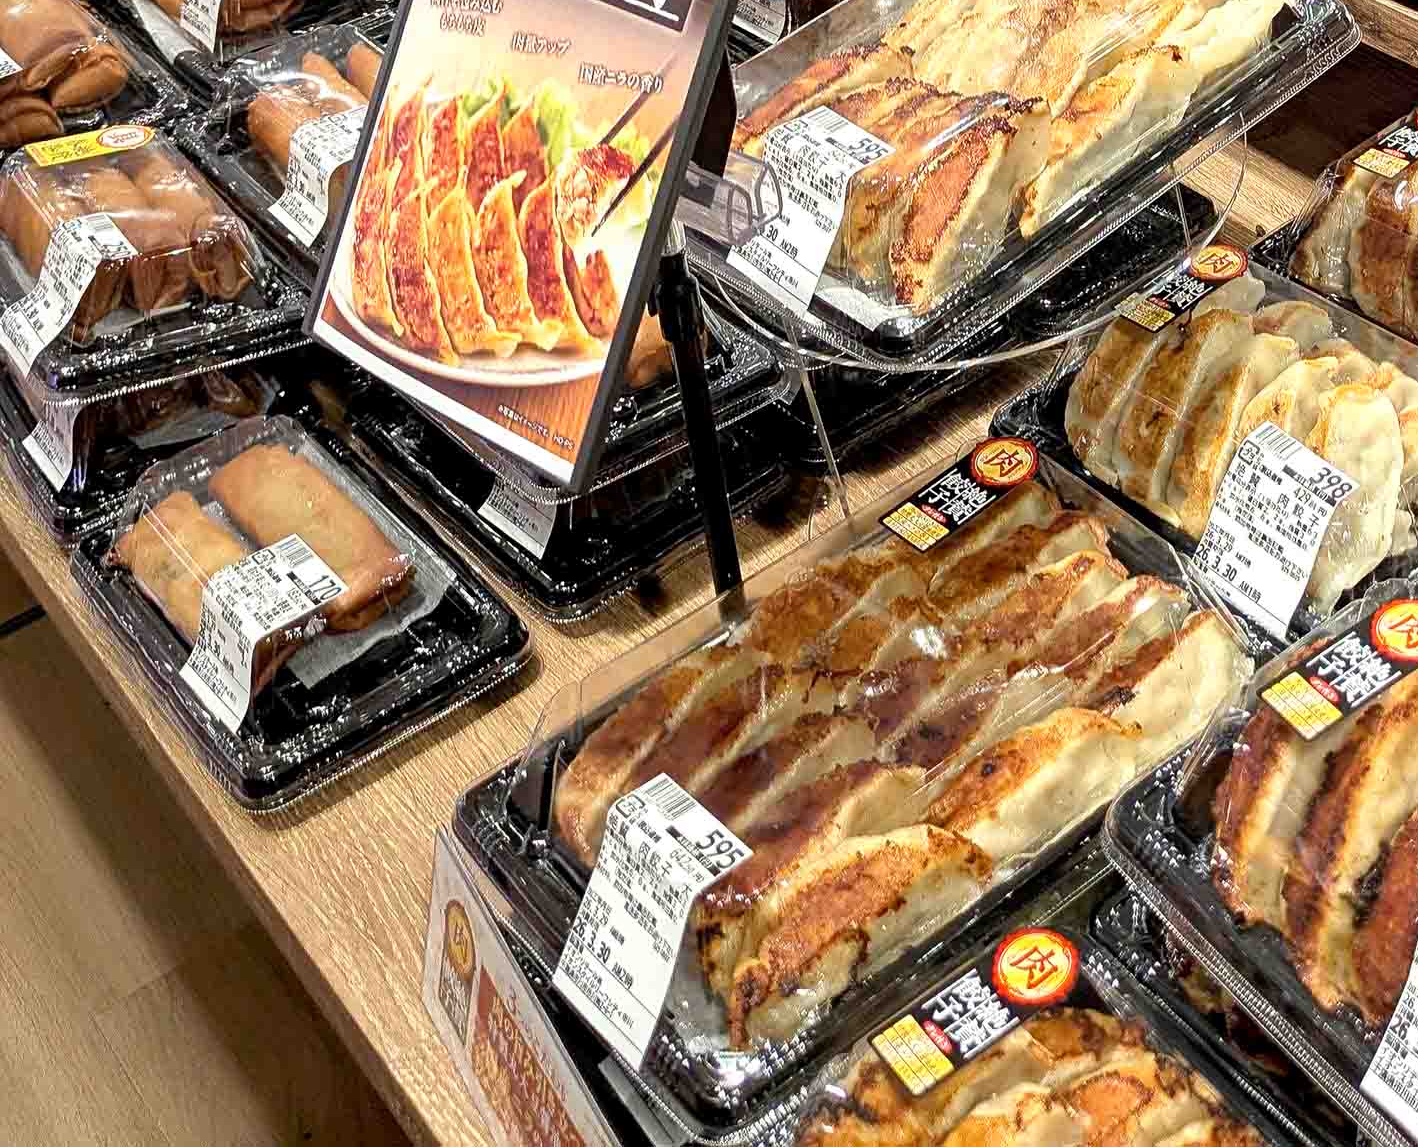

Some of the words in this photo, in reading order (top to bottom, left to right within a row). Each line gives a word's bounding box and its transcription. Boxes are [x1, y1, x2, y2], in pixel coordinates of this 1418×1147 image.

[848, 136, 890, 162] 595
[1235, 462, 1261, 488] 絶賛
[1277, 493, 1320, 528] 肉餃子
[1309, 466, 1353, 499] 398
[1205, 529, 1233, 553] 26.3.29
[308, 573, 343, 601] 170
[1195, 543, 1238, 583] 26.3.30
[1239, 580, 1263, 604] AM1時
[639, 840, 674, 876] 肉餃子
[694, 828, 746, 871] 595
[582, 896, 610, 927] 26.3.29
[571, 918, 612, 963] 26.3.30
[611, 963, 635, 990] AM2時
